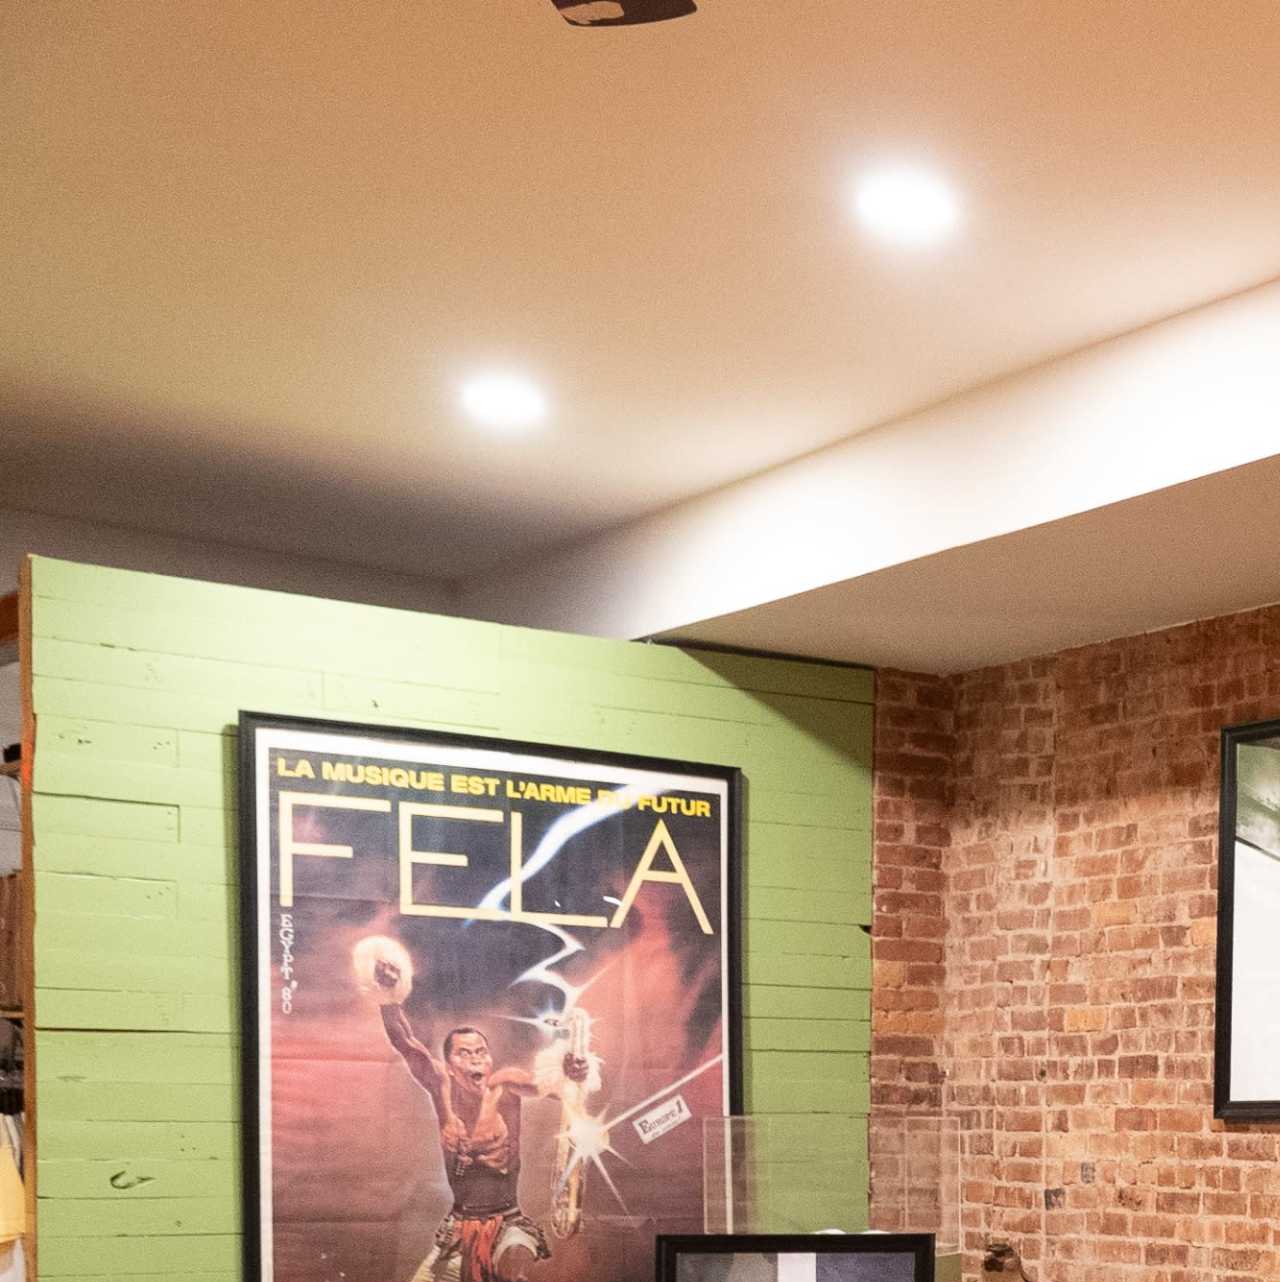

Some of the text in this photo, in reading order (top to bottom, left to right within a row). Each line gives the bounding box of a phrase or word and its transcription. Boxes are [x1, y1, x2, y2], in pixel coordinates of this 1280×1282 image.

[276, 757, 315, 779] LA
[321, 761, 445, 793] MUSIQUE
[449, 774, 500, 797] EST
[506, 779, 592, 806] L'ARME
[637, 794, 712, 817] FUTUR
[278, 790, 715, 936] FELA
[279, 913, 295, 980] EGYPT
